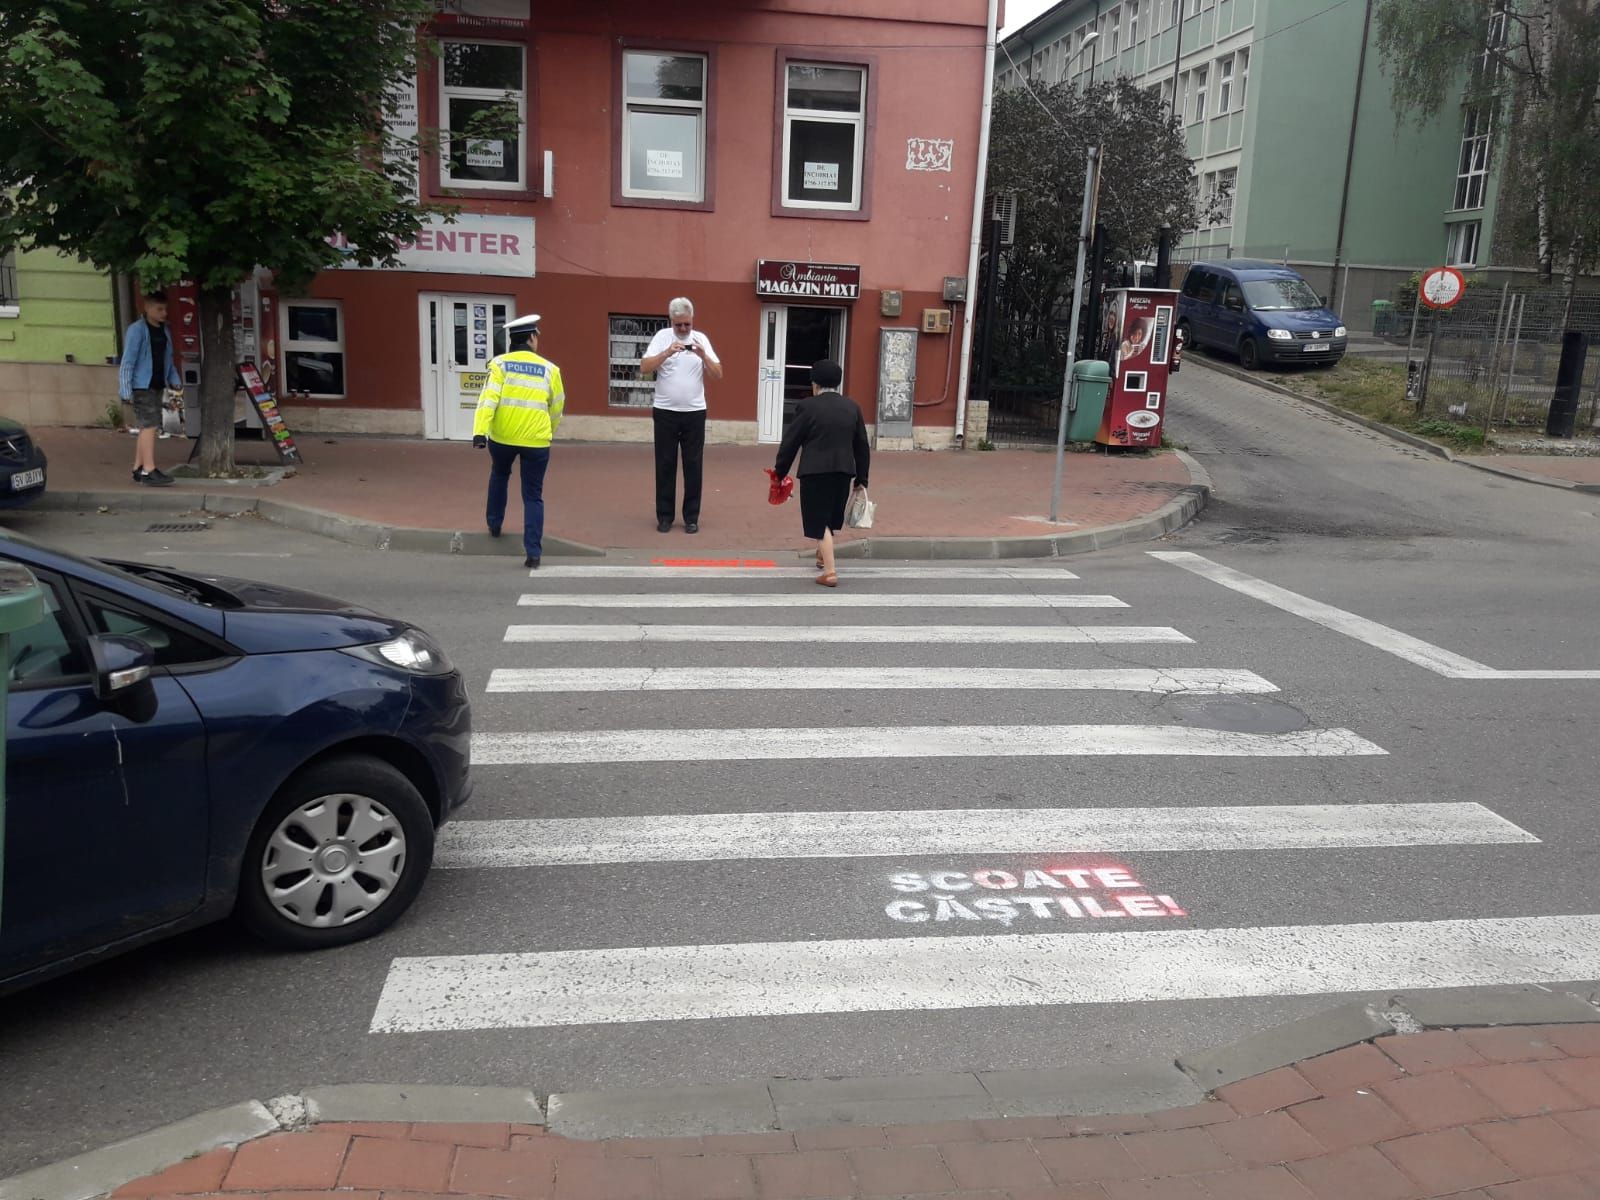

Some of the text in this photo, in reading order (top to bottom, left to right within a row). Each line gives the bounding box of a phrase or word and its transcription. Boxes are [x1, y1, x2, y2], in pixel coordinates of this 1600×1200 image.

[759, 279, 858, 297] MAGAZIN MIXT
[887, 868, 1142, 892] SCOATE
